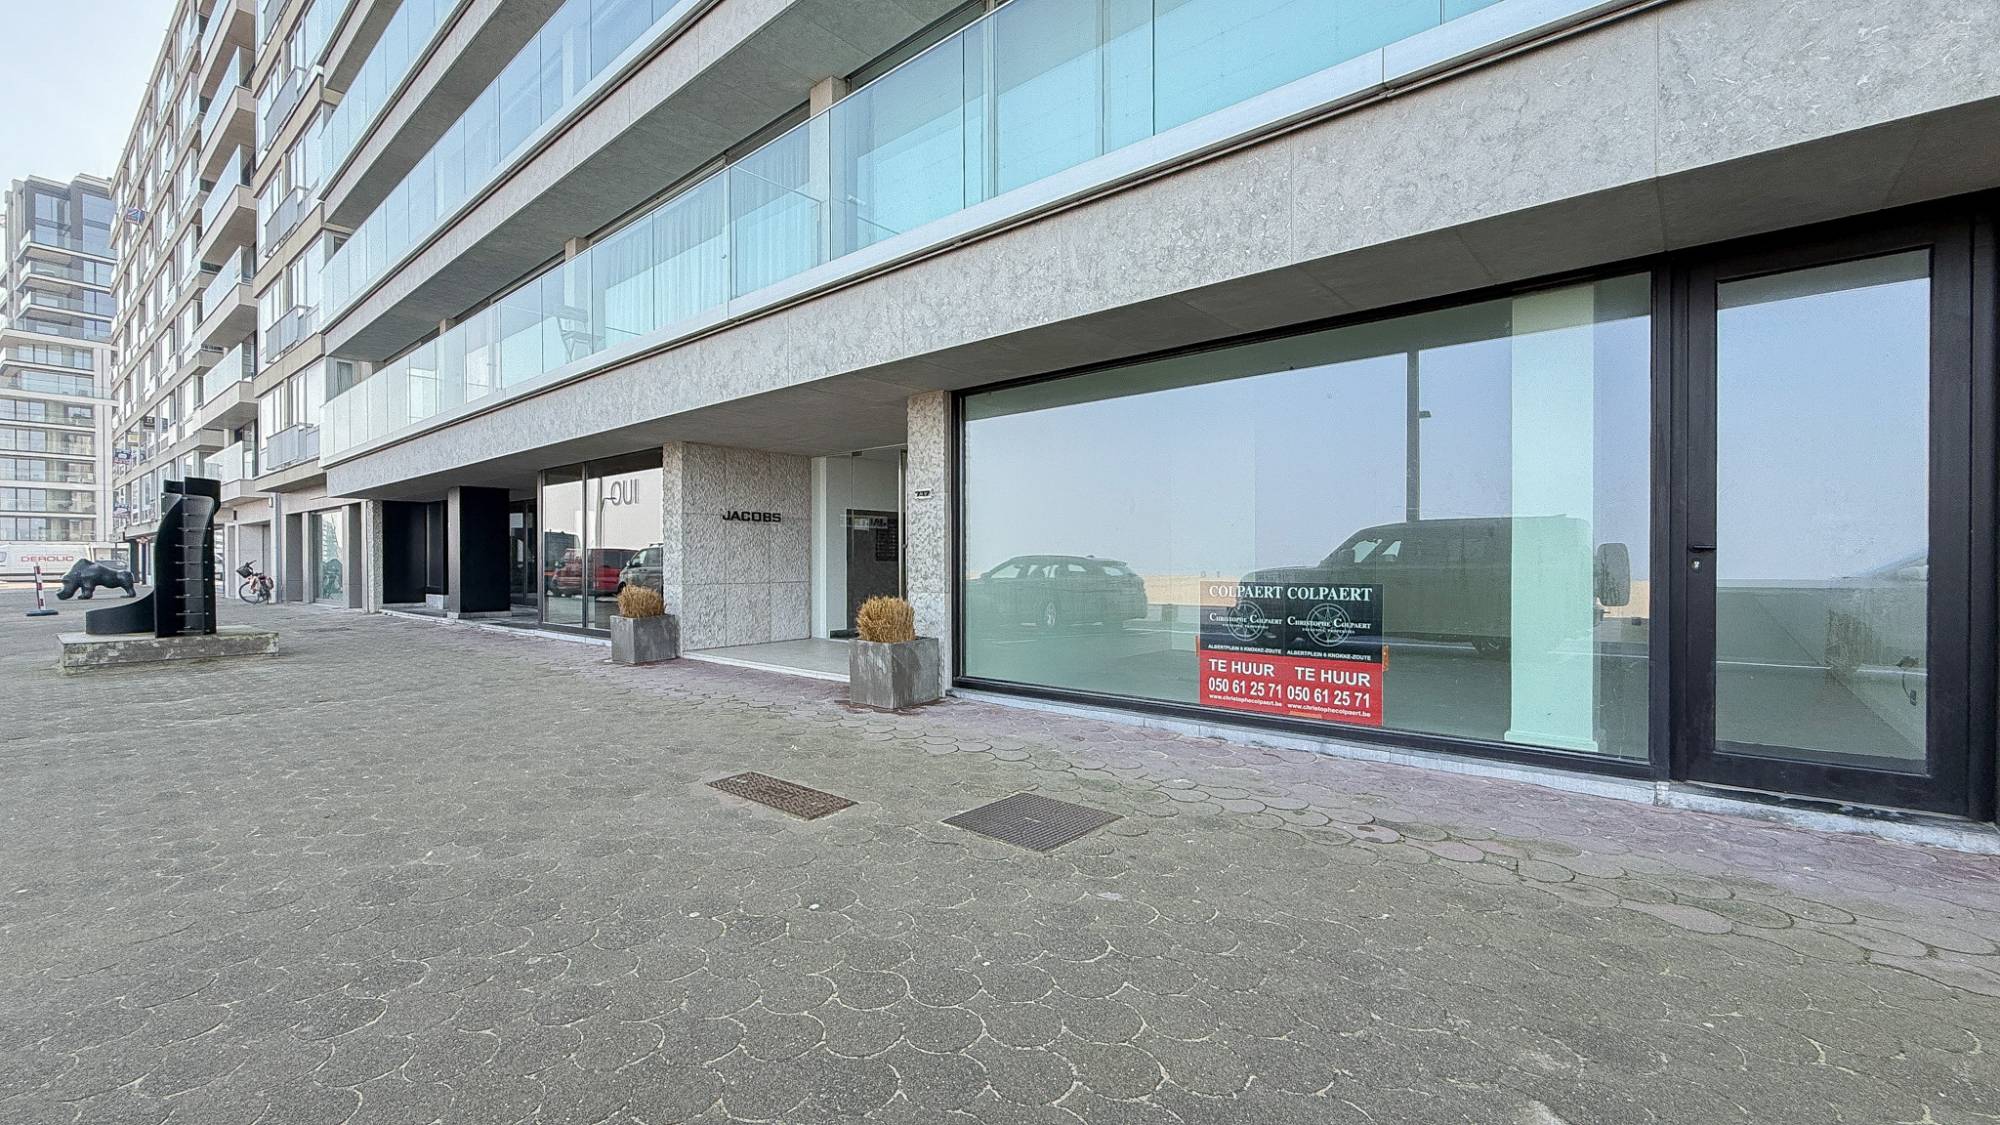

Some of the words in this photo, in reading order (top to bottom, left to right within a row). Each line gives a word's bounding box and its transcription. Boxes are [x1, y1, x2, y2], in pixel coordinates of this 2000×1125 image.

[722, 510, 782, 523] JACOBS
[1209, 585, 1284, 599] COLPAERT
[1287, 586, 1373, 602] COLPAERT
[1328, 653, 1372, 661] KNOKKE-ZOUTE
[1208, 658, 1227, 672] TE
[1231, 660, 1275, 677] HUUR
[1294, 666, 1316, 681] TE
[1321, 669, 1371, 688] HUUR
[1208, 676, 1229, 693] 050
[1232, 679, 1246, 695] 61
[1249, 681, 1265, 696] 25
[1268, 683, 1282, 699] 71
[1209, 694, 1282, 707] www.christophecolpaert.be
[1287, 685, 1310, 702] 050
[1314, 688, 1328, 704] 61
[1333, 690, 1350, 706] 25
[1354, 692, 1370, 708] 71
[1287, 703, 1371, 717] www.christophecolpaert.be
